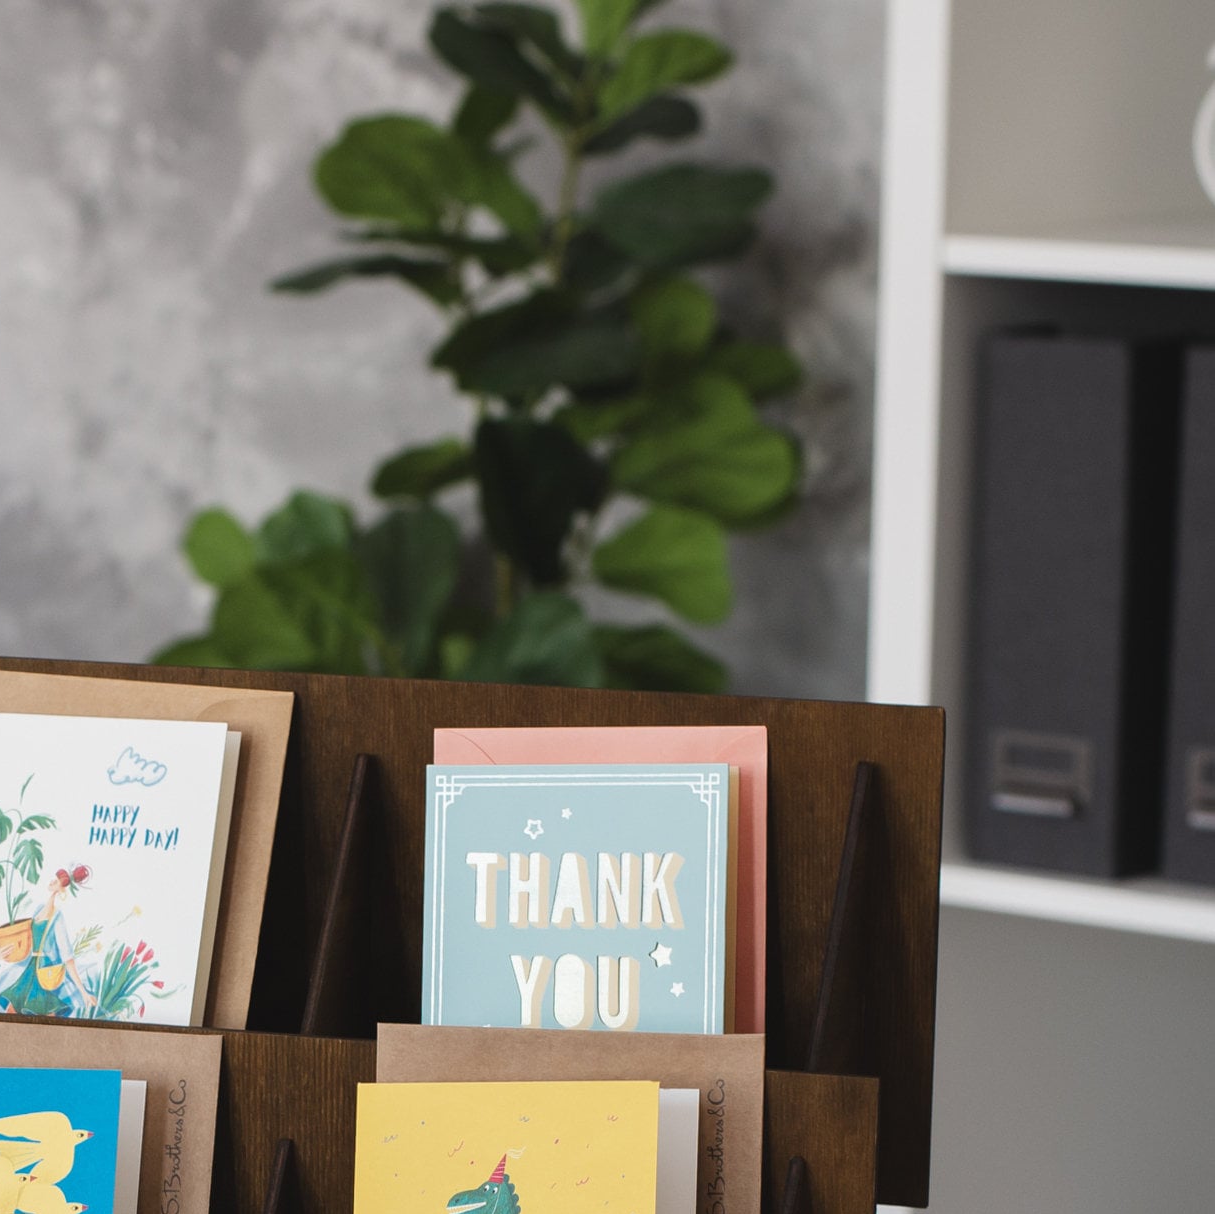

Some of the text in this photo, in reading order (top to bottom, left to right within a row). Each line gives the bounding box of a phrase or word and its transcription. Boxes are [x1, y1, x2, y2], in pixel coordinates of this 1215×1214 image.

[89, 826, 180, 851] HAPPY DAY!
[92, 804, 140, 826] HAPPY
[466, 852, 684, 929] THANK
[510, 953, 641, 1031] YOU
